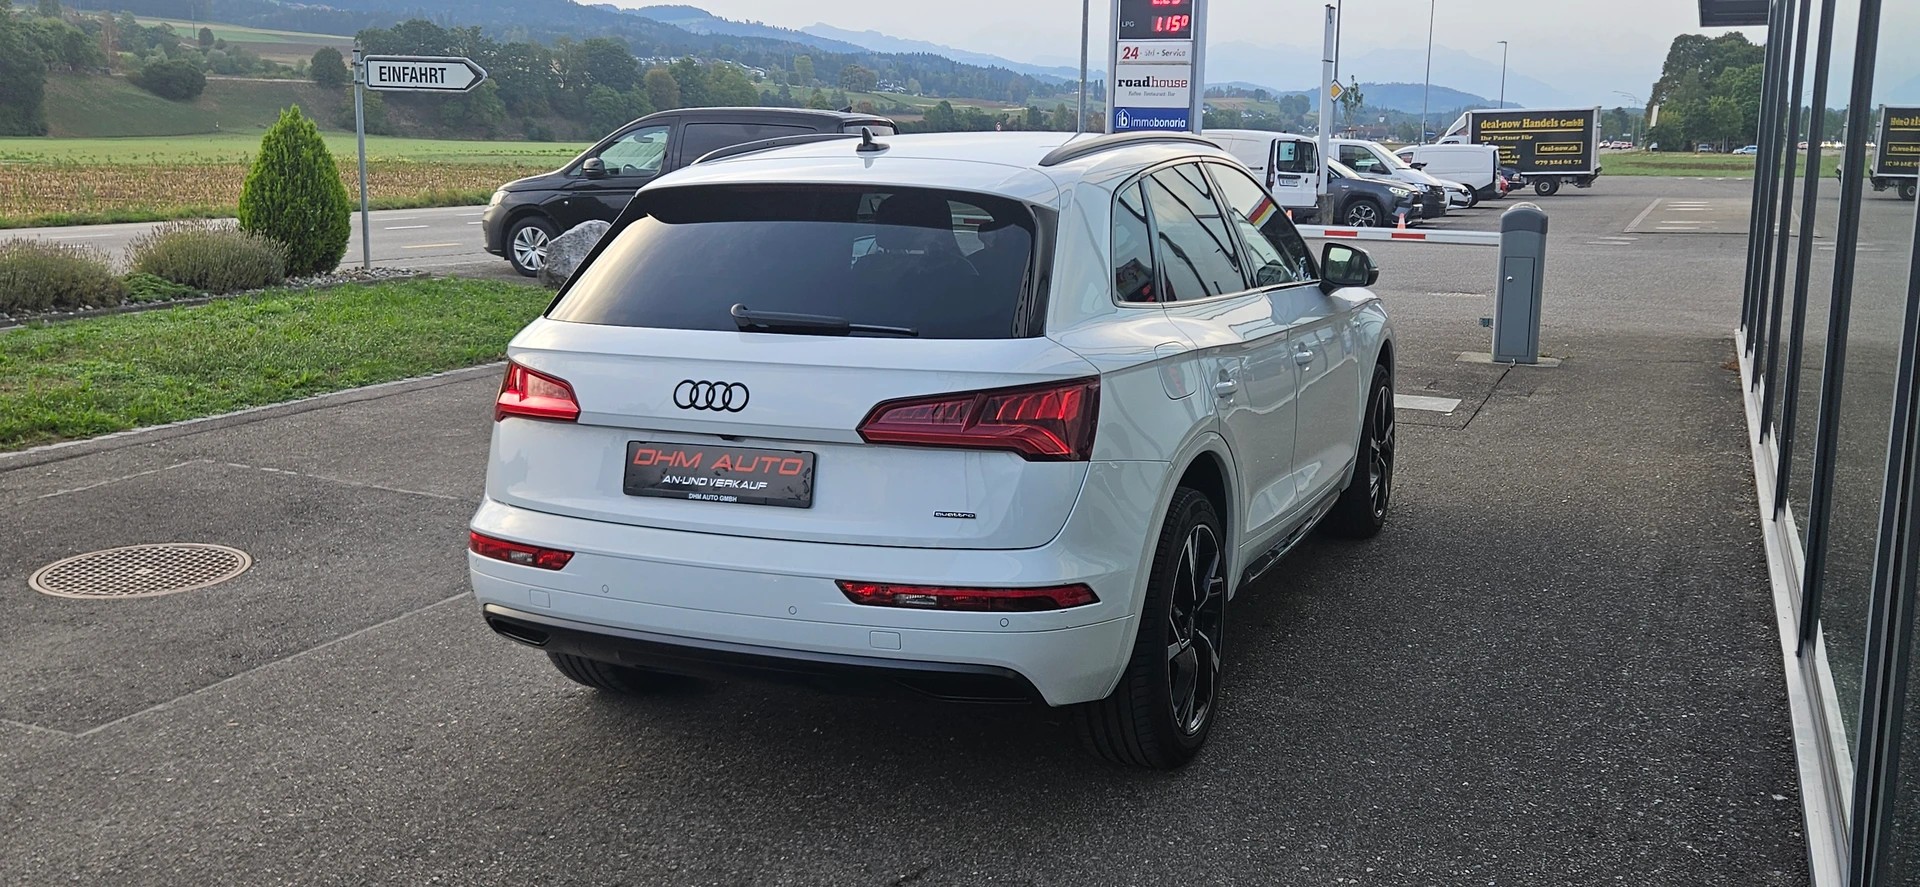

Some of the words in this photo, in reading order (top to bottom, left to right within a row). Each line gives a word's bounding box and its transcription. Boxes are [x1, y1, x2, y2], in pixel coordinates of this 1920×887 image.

[1122, 46, 1139, 60] 24
[379, 66, 447, 84] EINFAHRT
[1118, 76, 1188, 88] roadhouse
[1131, 117, 1186, 128] immobonaria
[1480, 120, 1522, 129] deal-now
[1522, 118, 1559, 128] Handels
[1560, 118, 1584, 127] GmbH
[633, 448, 703, 469] DHM
[711, 454, 804, 476] AUTO
[662, 475, 709, 486] AN-UND
[709, 478, 768, 490] VERKAUF
[719, 495, 738, 503] GMBH
